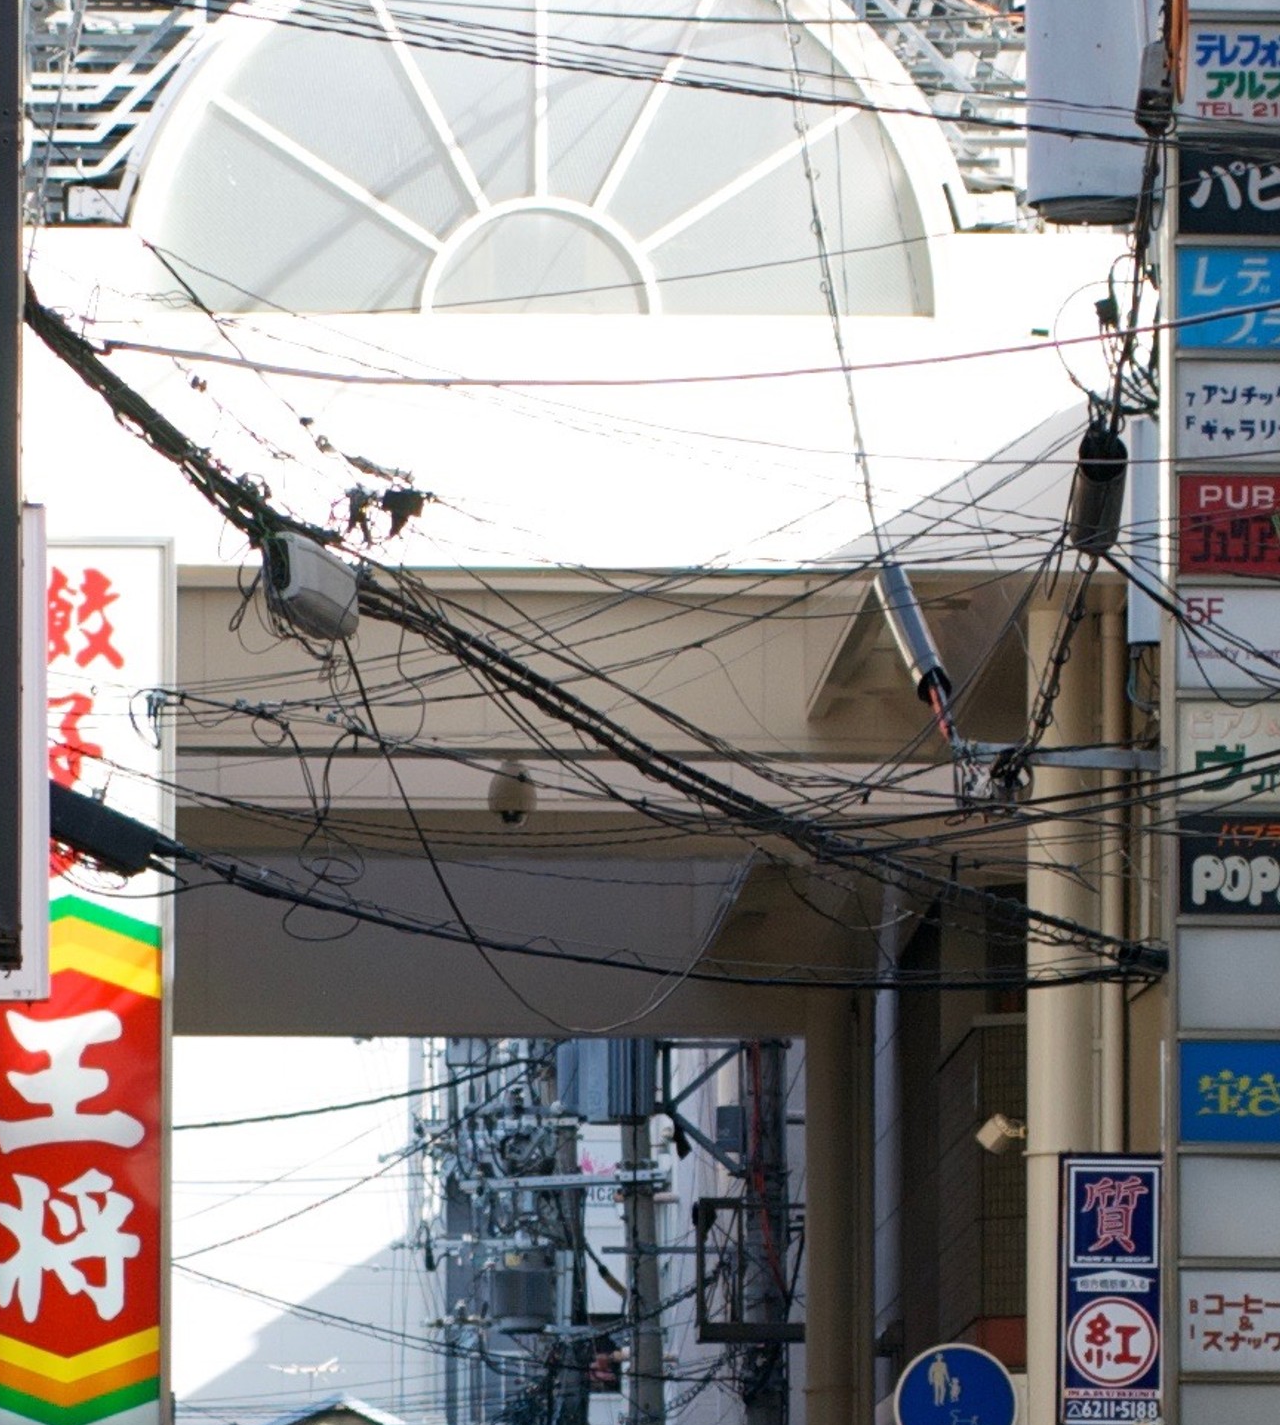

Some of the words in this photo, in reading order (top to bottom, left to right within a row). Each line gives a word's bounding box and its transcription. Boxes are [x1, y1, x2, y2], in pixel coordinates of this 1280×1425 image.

[1196, 101, 1243, 117] TEL
[1199, 484, 1276, 509] PUB
[1186, 597, 1224, 625] 5F
[1081, 1175, 1149, 1254] 質
[1084, 1312, 1142, 1369] 紅
